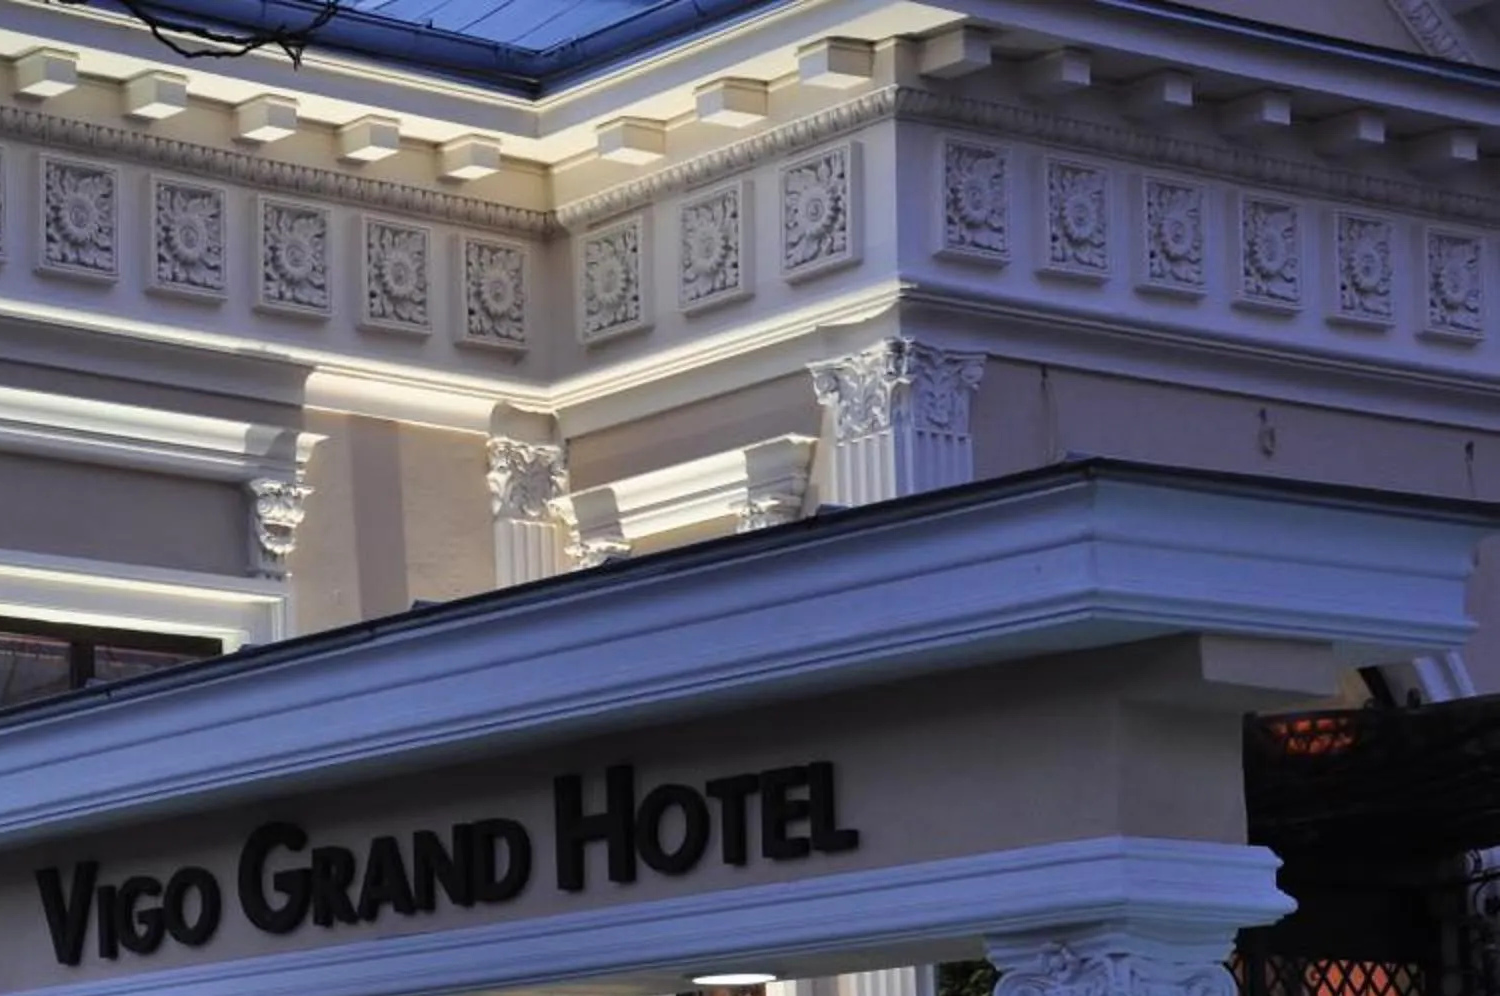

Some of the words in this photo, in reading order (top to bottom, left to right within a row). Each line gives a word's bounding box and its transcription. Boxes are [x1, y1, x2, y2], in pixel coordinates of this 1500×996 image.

[36, 860, 221, 966] VIGO
[237, 817, 531, 934] GRAND
[554, 761, 859, 892] HOTEL
